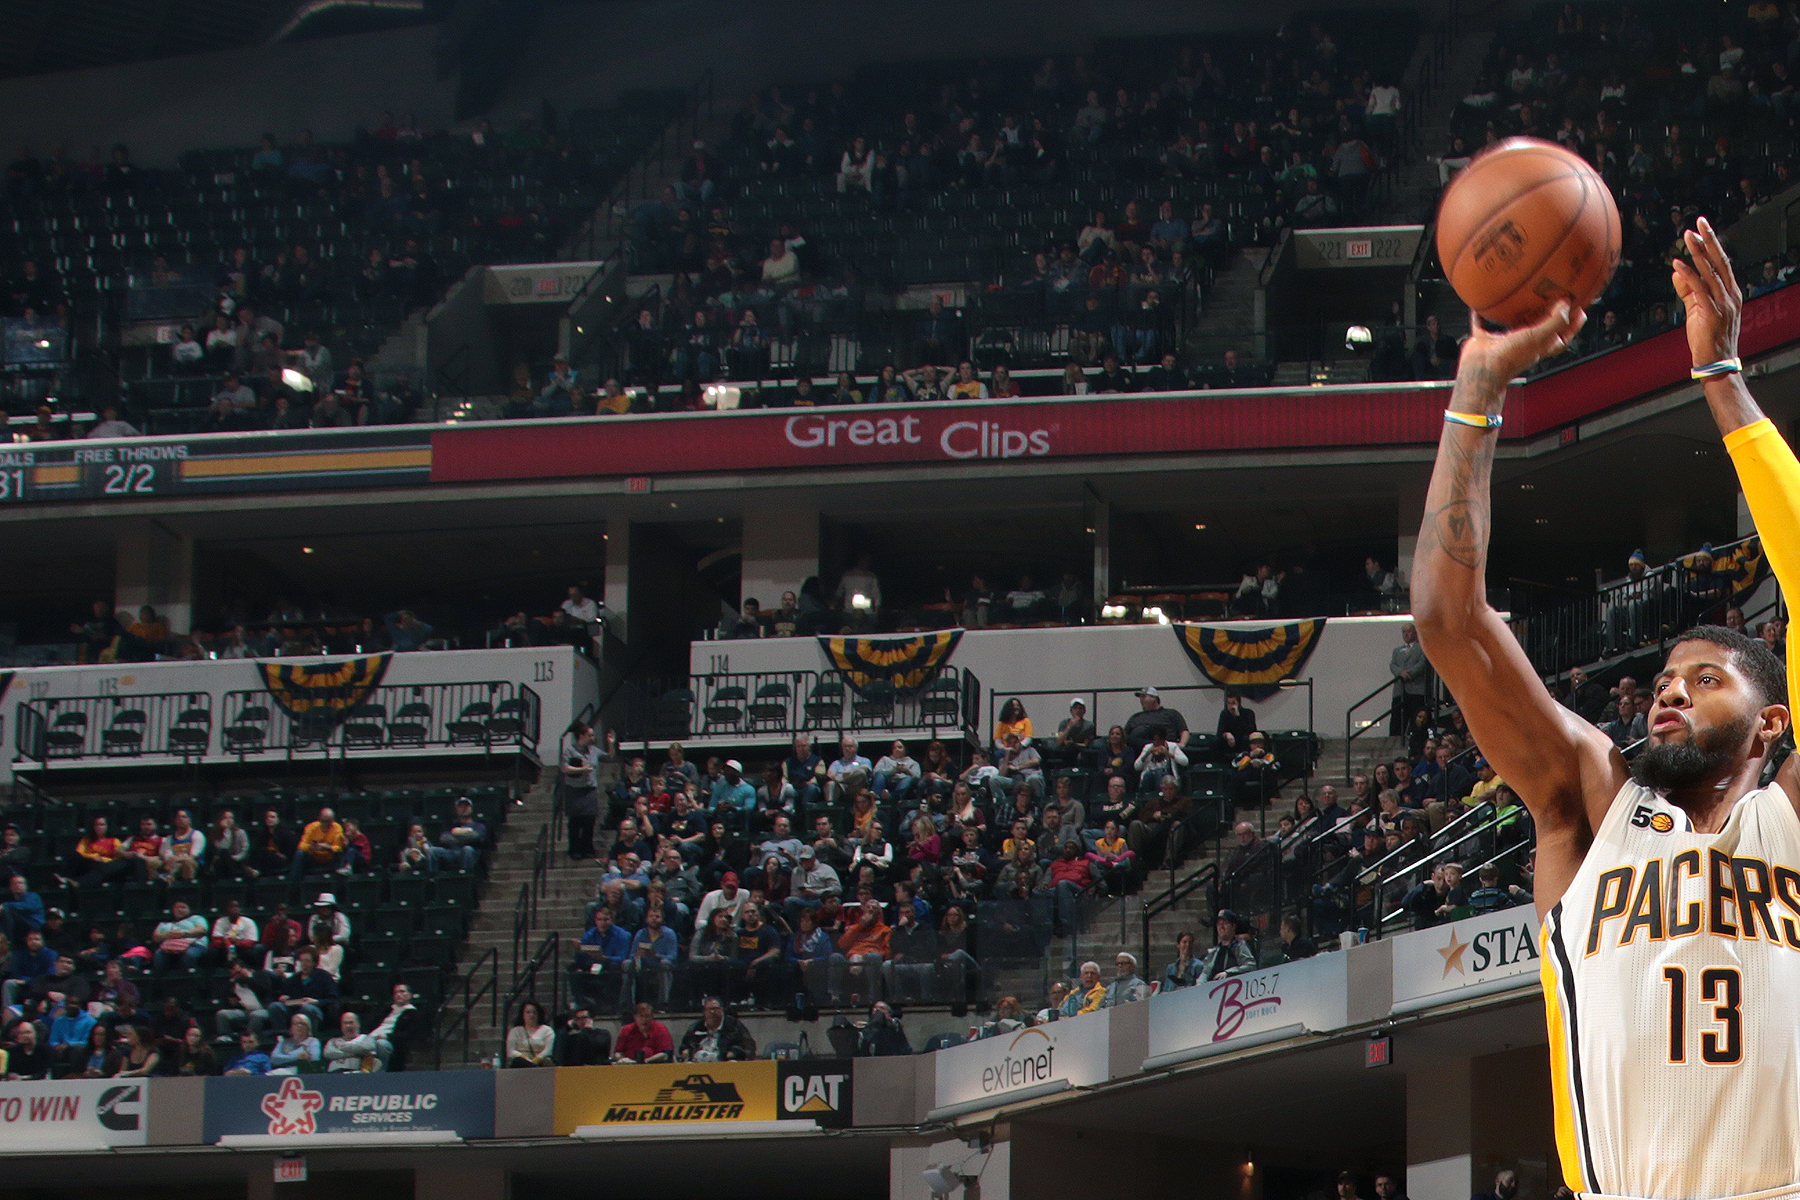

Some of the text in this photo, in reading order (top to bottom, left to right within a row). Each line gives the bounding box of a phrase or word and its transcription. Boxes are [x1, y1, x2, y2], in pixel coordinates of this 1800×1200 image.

[1352, 243, 1369, 256] EXIT
[785, 414, 1050, 458] Great Clips
[74, 445, 189, 464] FREE THROWS
[104, 464, 155, 494] 2/2
[534, 661, 553, 682] 113
[1473, 922, 1540, 972] STA
[1245, 973, 1279, 999] 105.7
[1660, 963, 1746, 1067] 13
[1369, 1041, 1386, 1063] EXIT
[982, 1045, 1055, 1093] extenet
[329, 1093, 438, 1112] REPUBLIC
[784, 1074, 844, 1113] CAT
[30, 1096, 81, 1122] WIN
[352, 1112, 413, 1124] SERVICES
